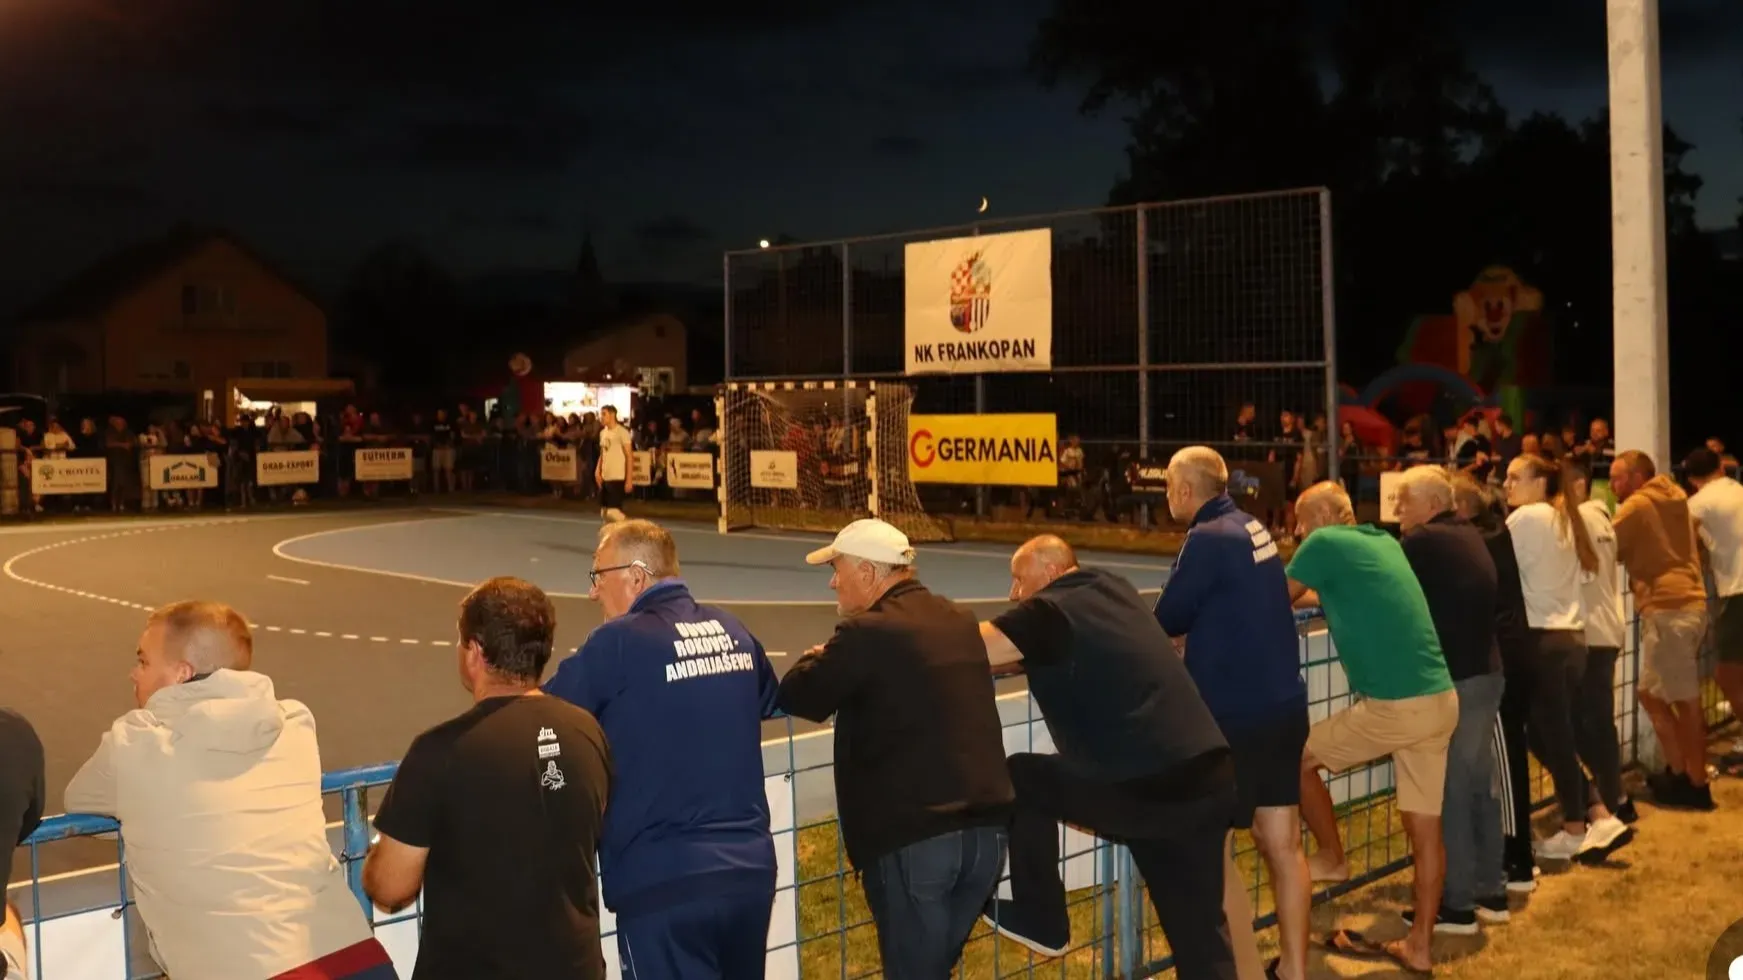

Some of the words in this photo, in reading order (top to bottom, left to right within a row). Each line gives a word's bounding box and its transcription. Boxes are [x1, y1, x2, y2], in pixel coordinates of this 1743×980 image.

[914, 344, 935, 363] NK
[938, 338, 1036, 361] FRANKOPAN
[938, 437, 1054, 462] GERMANIA
[673, 633, 734, 658] ROKOVCI
[665, 651, 754, 682] ANDRIJAŠEVCI
